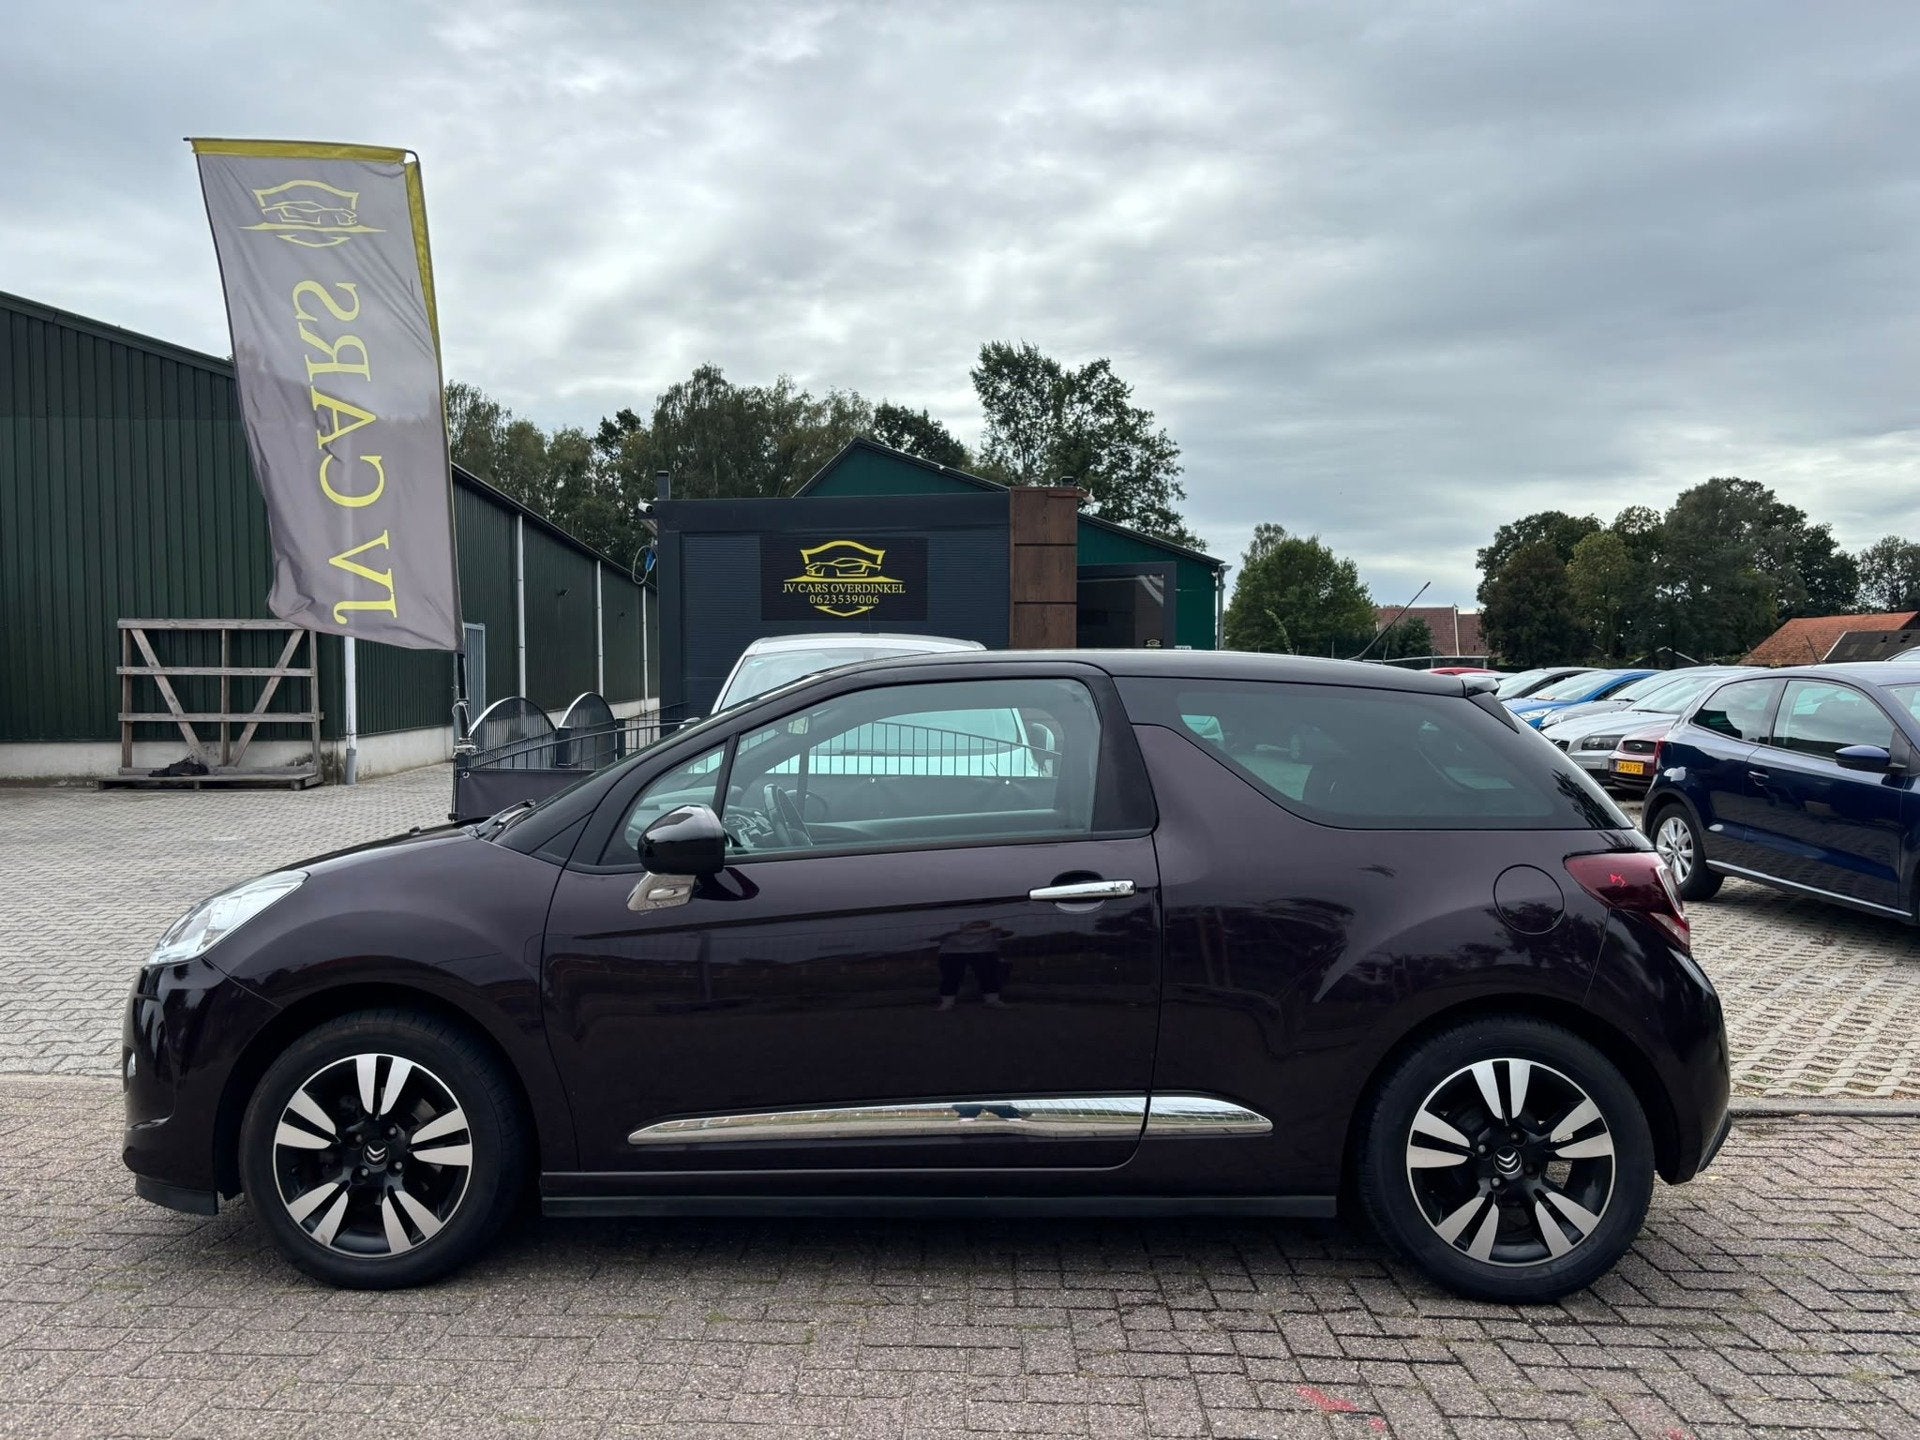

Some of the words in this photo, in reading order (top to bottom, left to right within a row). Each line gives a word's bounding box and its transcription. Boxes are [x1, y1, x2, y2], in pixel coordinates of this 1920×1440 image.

[782, 583, 798, 594] JV
[798, 583, 829, 594] CARS
[830, 583, 906, 594] OVERDINKEL
[809, 595, 880, 604] 0623539006
